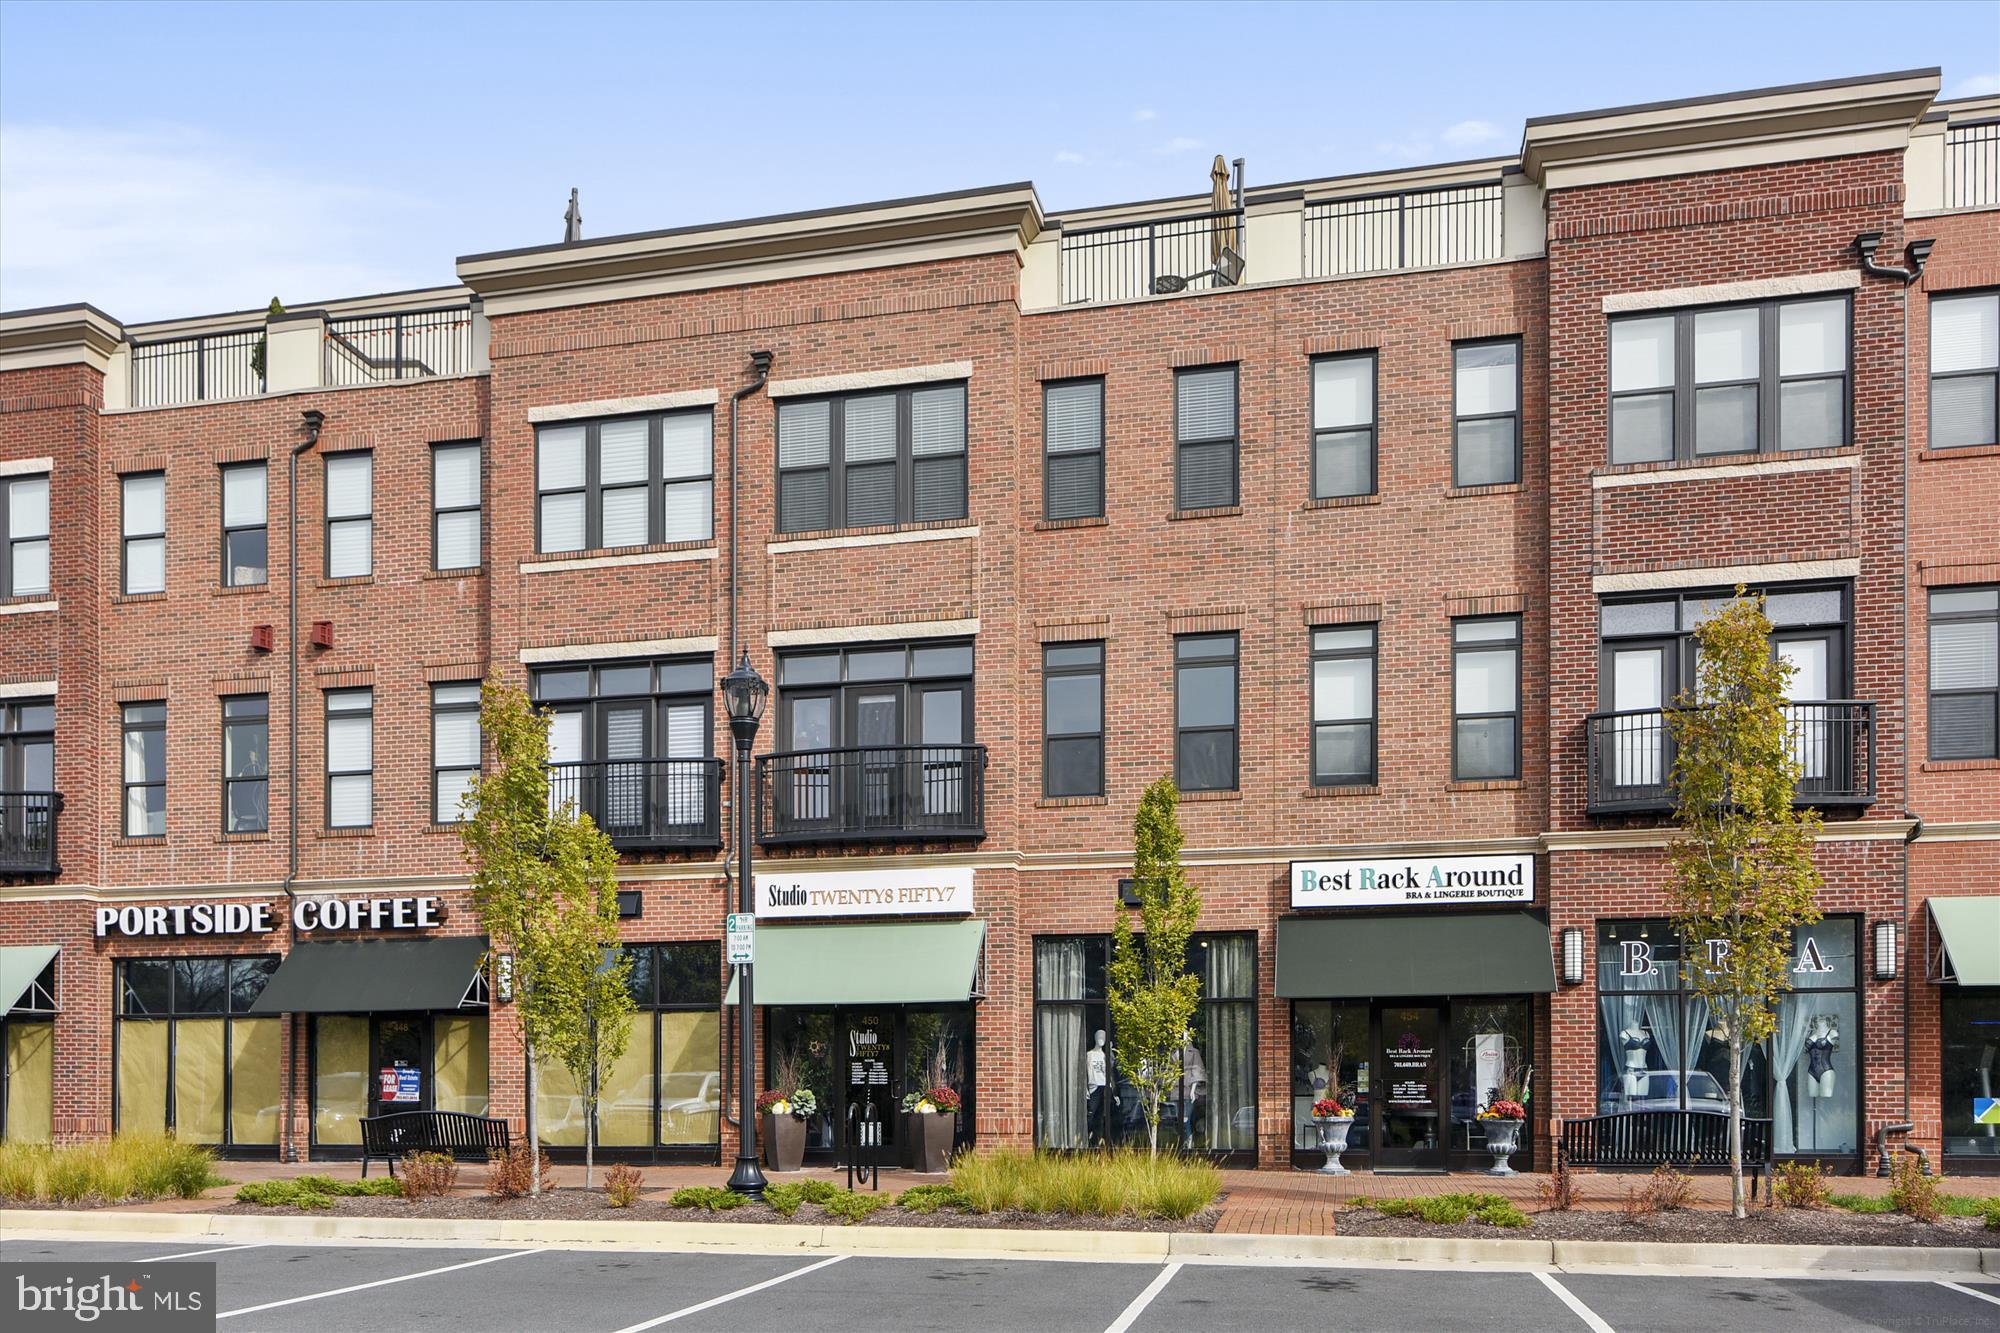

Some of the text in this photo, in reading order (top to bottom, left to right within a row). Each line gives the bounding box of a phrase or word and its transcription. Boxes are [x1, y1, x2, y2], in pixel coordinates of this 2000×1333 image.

[1300, 864, 1524, 892] Best Rack Around
[768, 884, 956, 907] Studio TWENTY8 FIFTY7
[1405, 888, 1524, 899] BRA & LINGERIE BOUTIQUE
[95, 897, 441, 937] PORTSIDE COFFEE
[729, 918, 736, 931] 2
[1620, 940, 1658, 975] B.
[1792, 937, 1834, 973] A.
[864, 1016, 879, 1025] 450
[850, 1029, 878, 1057] Studio
[383, 1074, 396, 1085] FOR
[383, 1085, 398, 1093] LEASE
